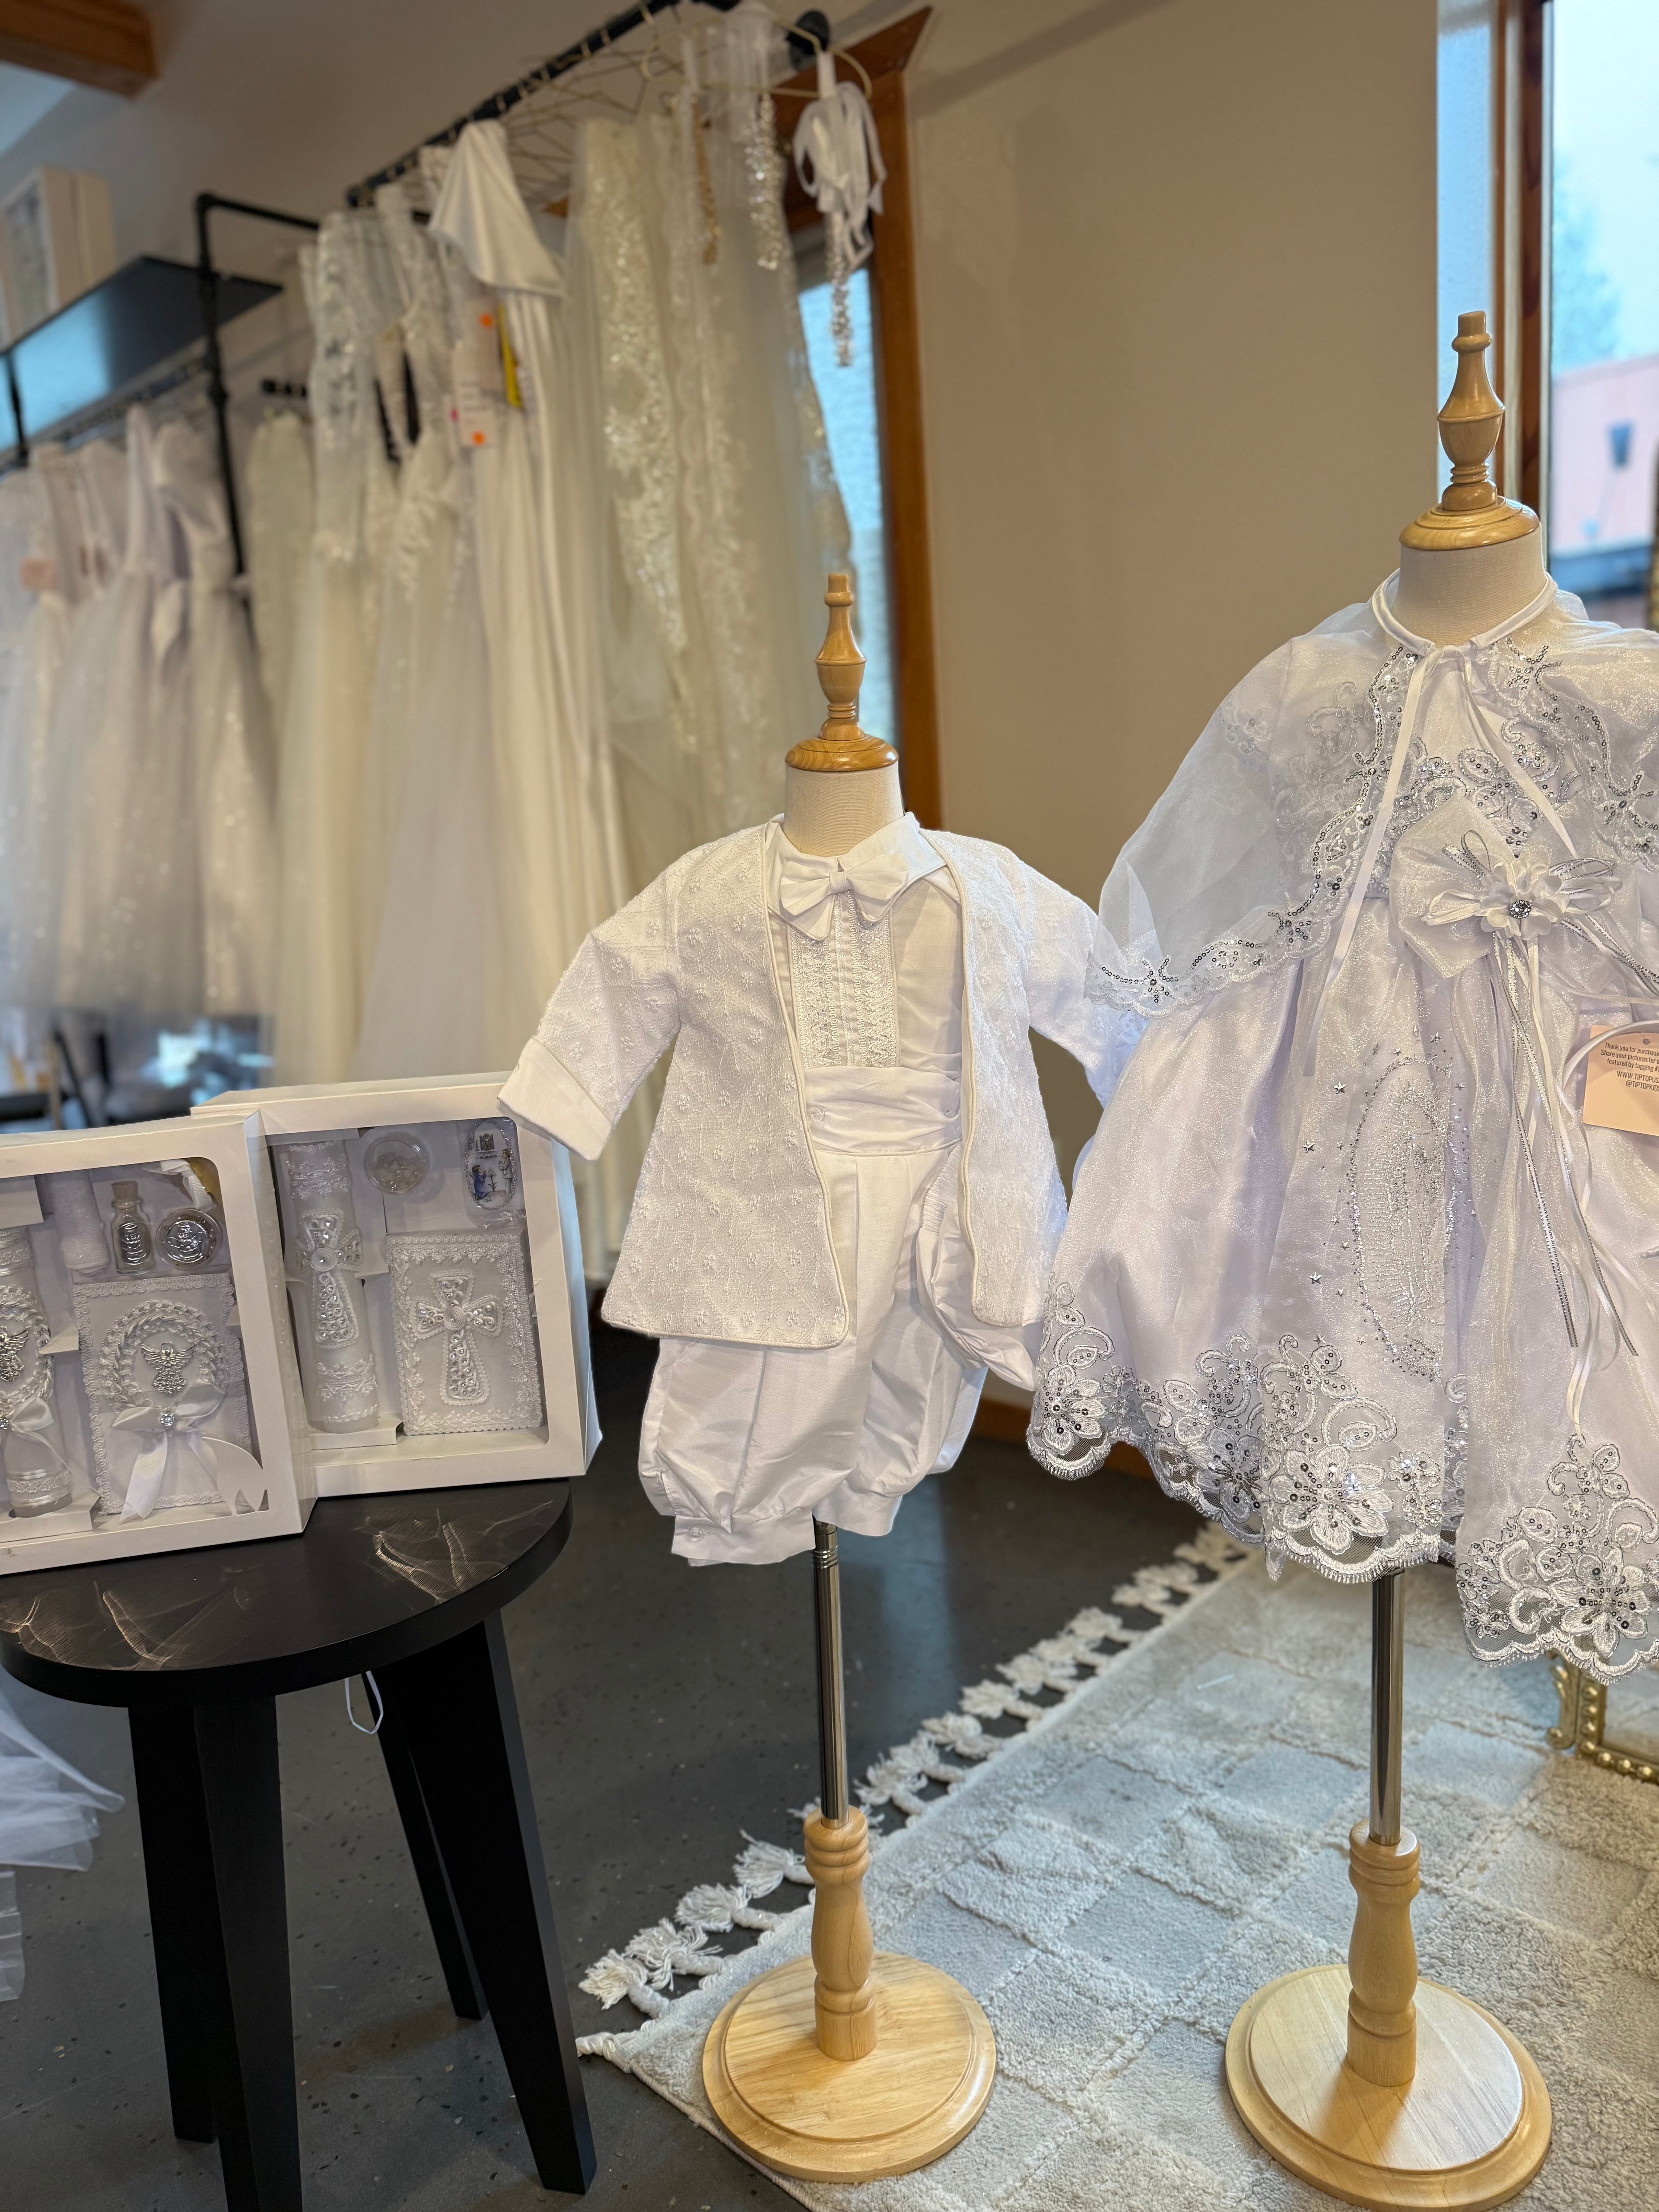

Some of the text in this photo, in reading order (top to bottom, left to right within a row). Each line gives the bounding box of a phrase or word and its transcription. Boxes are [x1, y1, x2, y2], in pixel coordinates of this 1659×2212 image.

[1628, 1054, 1648, 1062] pictures
[1607, 1058, 1627, 1067] featured
[1635, 1063, 1654, 1072] tagging
